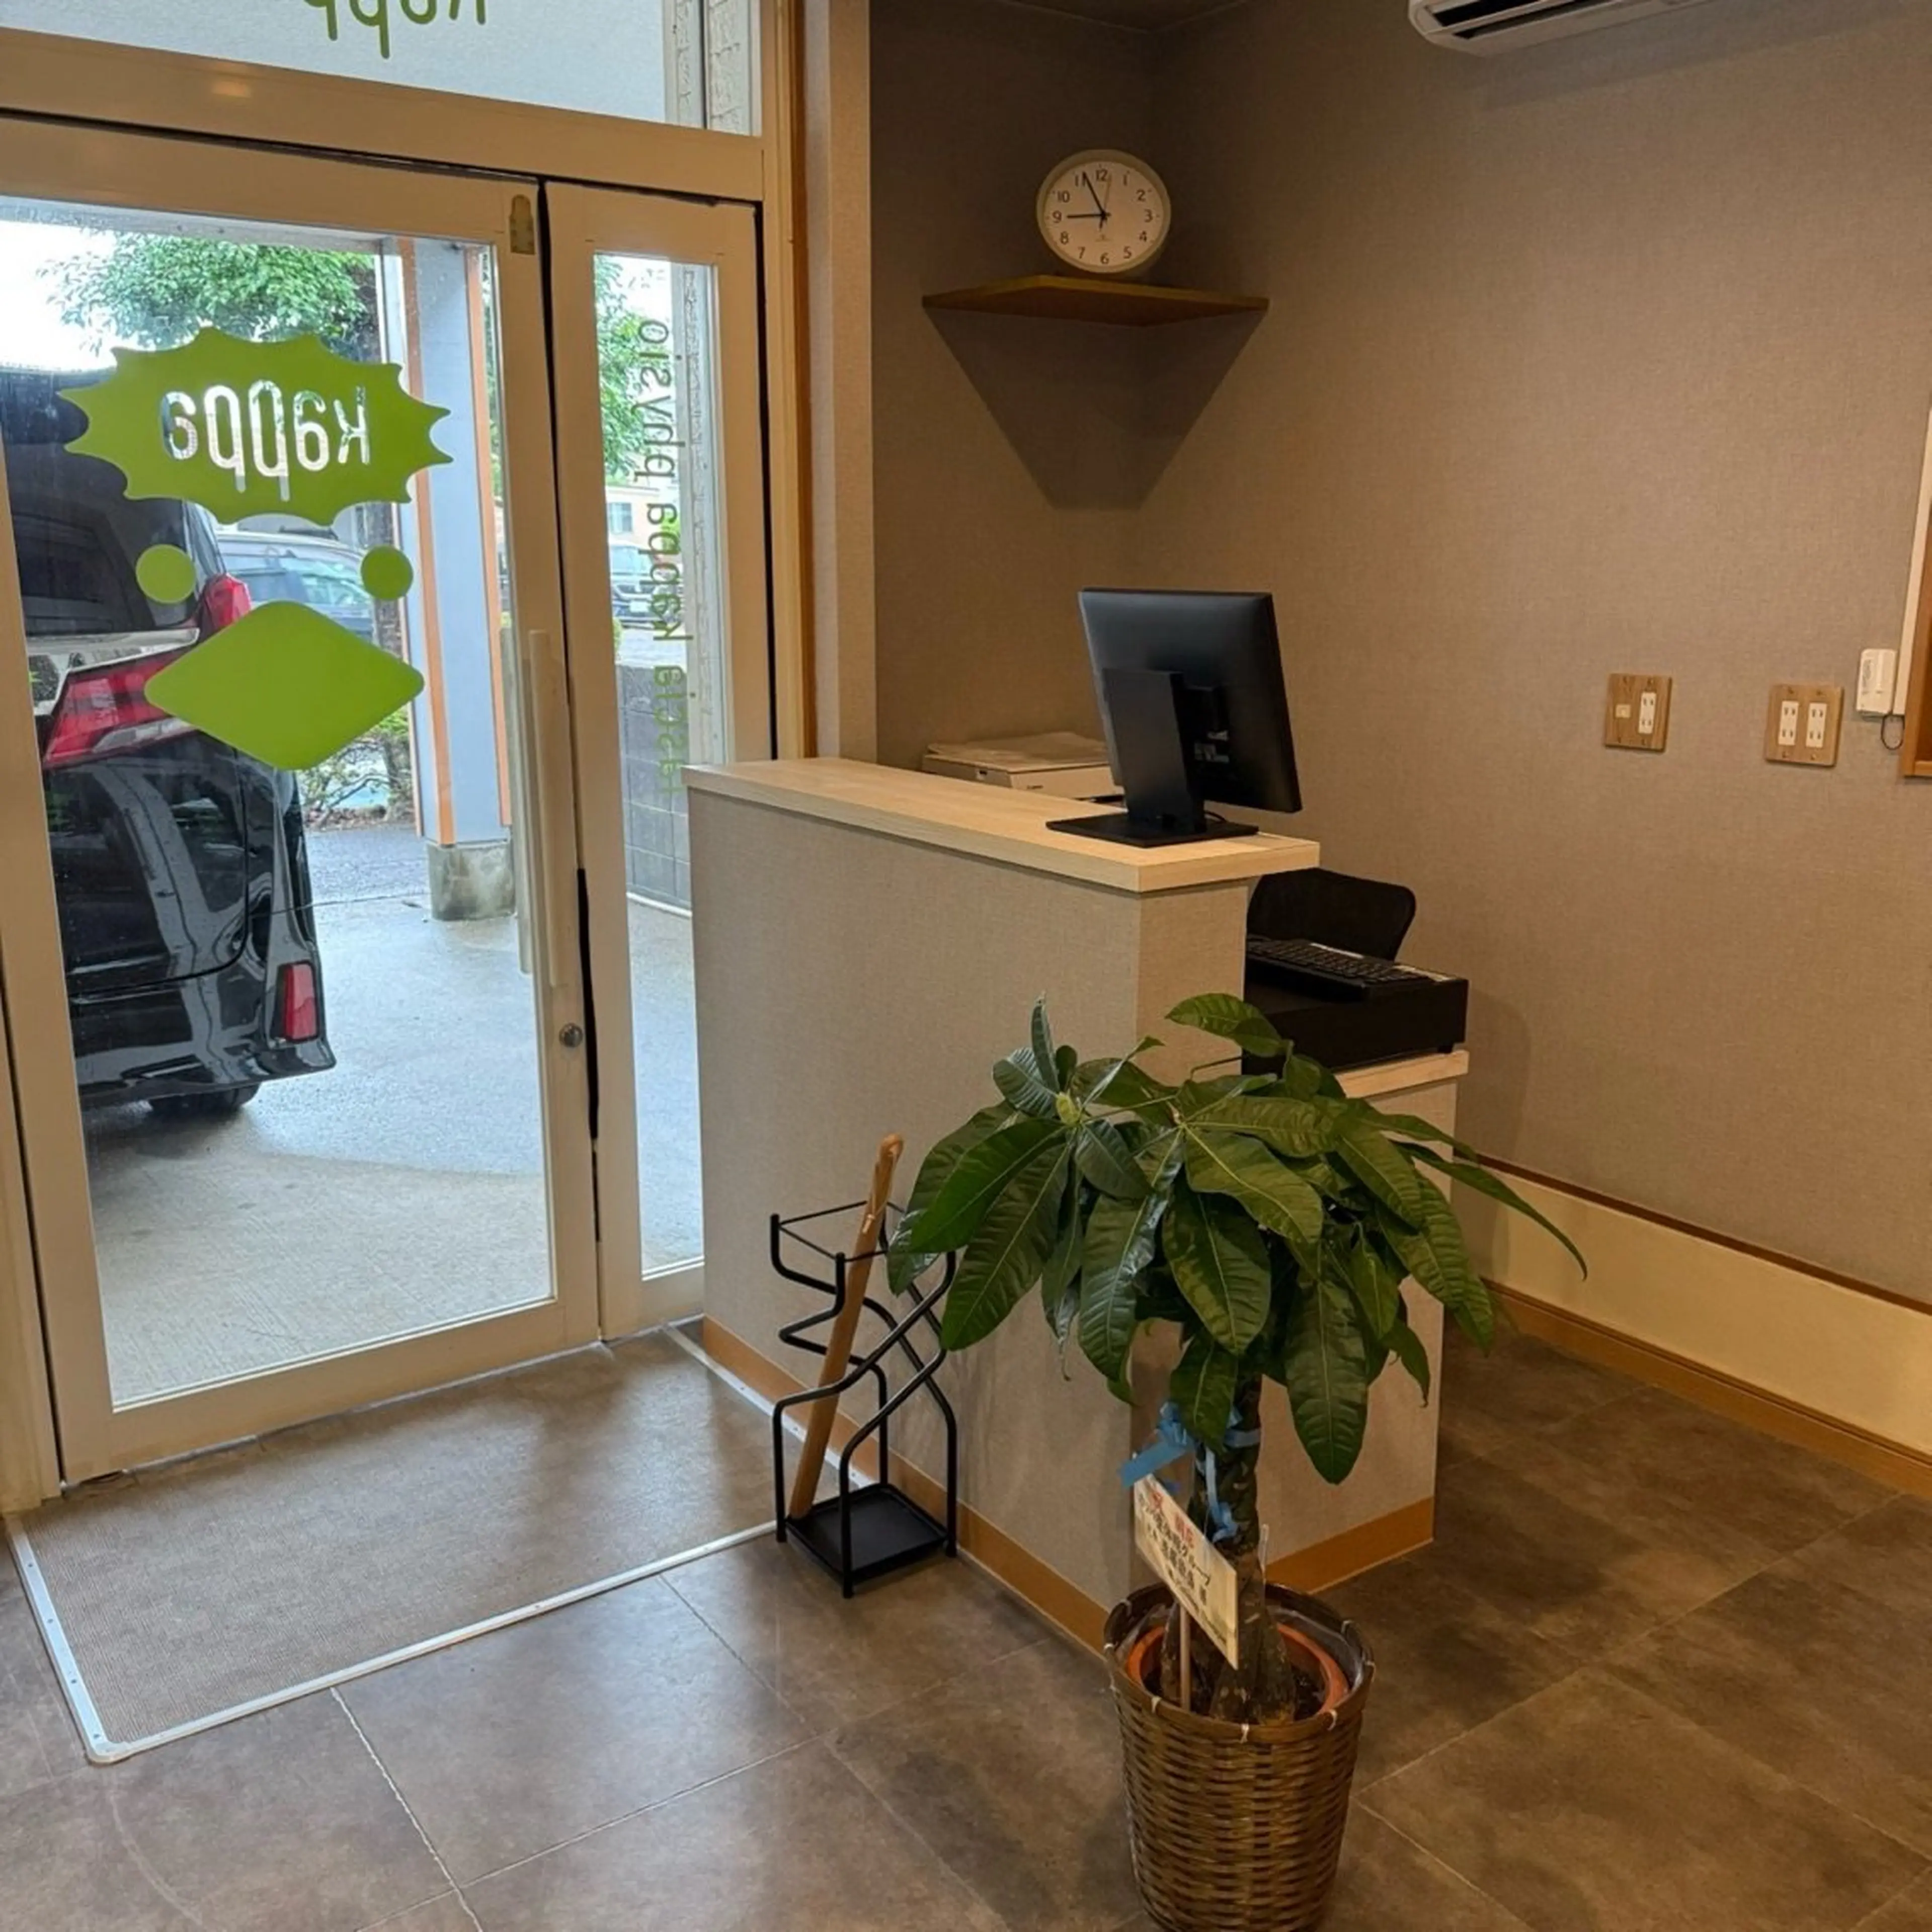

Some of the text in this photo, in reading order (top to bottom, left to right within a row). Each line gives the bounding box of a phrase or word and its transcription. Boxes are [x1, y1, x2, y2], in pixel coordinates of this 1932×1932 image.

[1095, 169, 1108, 182] 12
[1057, 191, 1070, 203] 10
[1136, 189, 1146, 201] 2
[1053, 211, 1062, 223] 9
[1144, 209, 1153, 222] 3
[1060, 231, 1069, 245] 8
[1139, 230, 1147, 242] 4
[1078, 247, 1086, 259] 7
[1123, 246, 1132, 259] 5
[1100, 253, 1109, 265] 6
